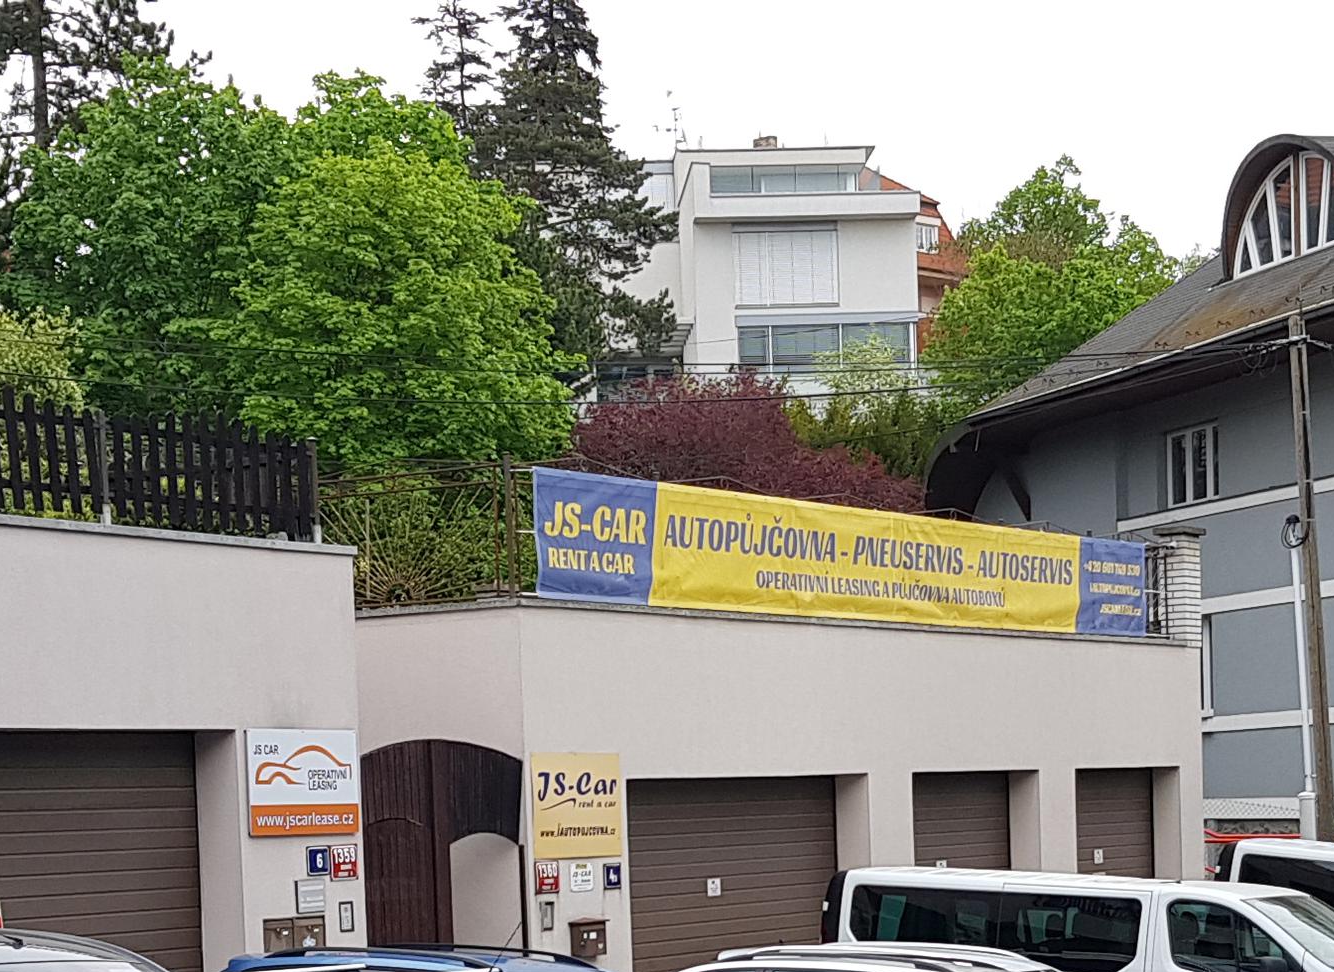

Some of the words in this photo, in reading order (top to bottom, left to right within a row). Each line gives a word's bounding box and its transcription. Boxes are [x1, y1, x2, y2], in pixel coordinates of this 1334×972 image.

[544, 501, 647, 545] JS-CAR
[664, 512, 836, 563] AUTOPŮJČOVNA
[852, 535, 964, 575] PNEUSERVIS
[976, 550, 1073, 586] AUTOSERVIS
[547, 547, 588, 571] RENT
[589, 551, 601, 572] A
[602, 552, 636, 575] CAR
[755, 570, 829, 594] OPERATIVNÍ
[831, 577, 880, 598] LEASING
[881, 583, 891, 599] A
[254, 745, 262, 755] JS
[263, 744, 279, 755] CAR
[307, 768, 348, 780] OPERATIVNÍ
[308, 780, 338, 791] LEASING
[538, 771, 617, 802] JS-Car
[257, 811, 354, 830] www.jscarlease.cz
[316, 853, 324, 869] 6
[333, 847, 356, 863] 1359
[538, 864, 558, 878] 1360
